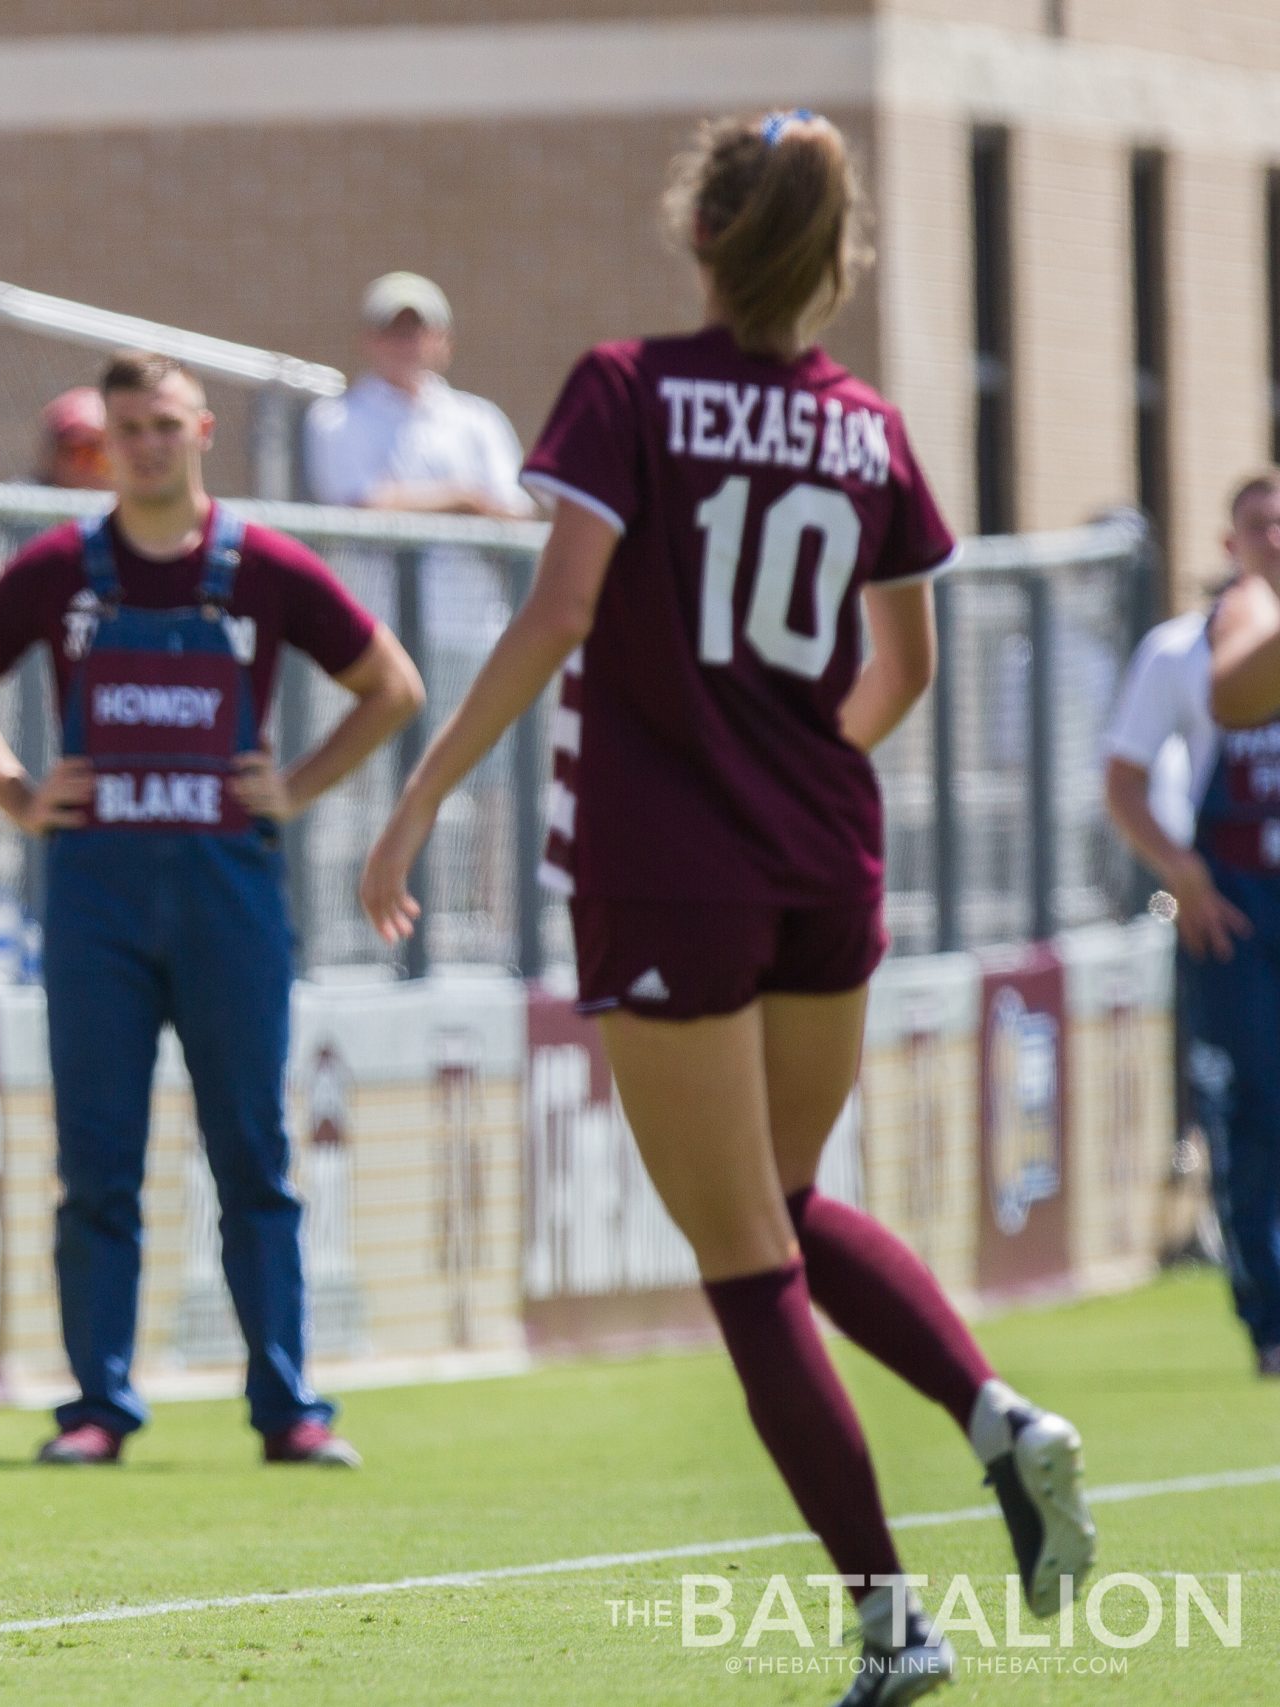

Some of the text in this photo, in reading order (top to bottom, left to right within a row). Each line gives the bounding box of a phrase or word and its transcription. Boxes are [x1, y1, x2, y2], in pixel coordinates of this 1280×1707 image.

[659, 377, 817, 468] TEXAS
[696, 475, 862, 681] 10
[92, 683, 222, 730] HOWDY
[95, 772, 223, 824] BLAKE
